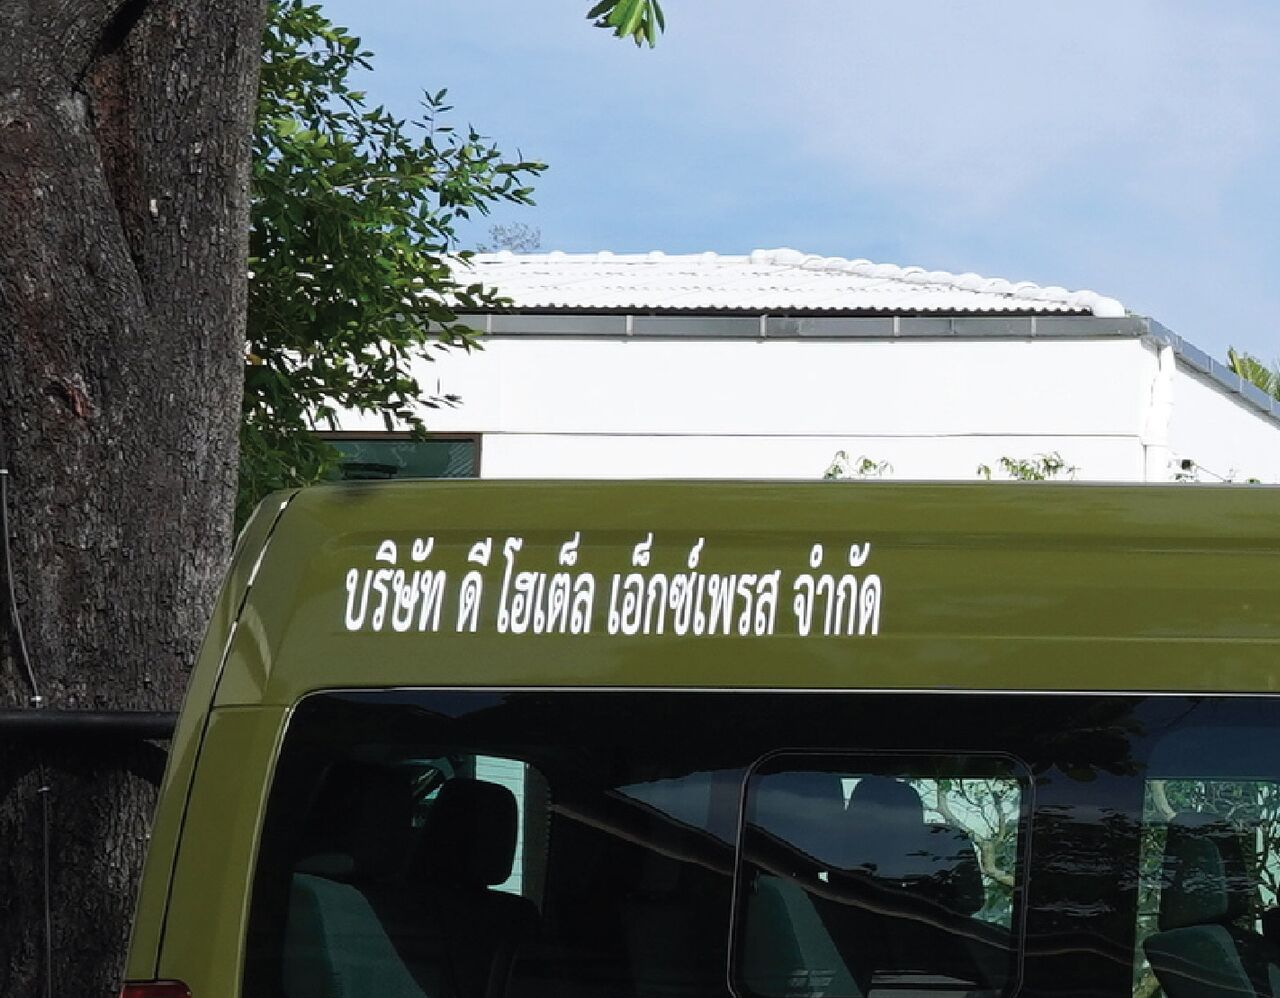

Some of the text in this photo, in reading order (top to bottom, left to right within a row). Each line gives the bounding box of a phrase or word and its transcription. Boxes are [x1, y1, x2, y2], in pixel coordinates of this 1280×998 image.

[344, 531, 882, 637] บริษัท ดี โฮเต็ล เอ็กซ์เพรส จำกัด
